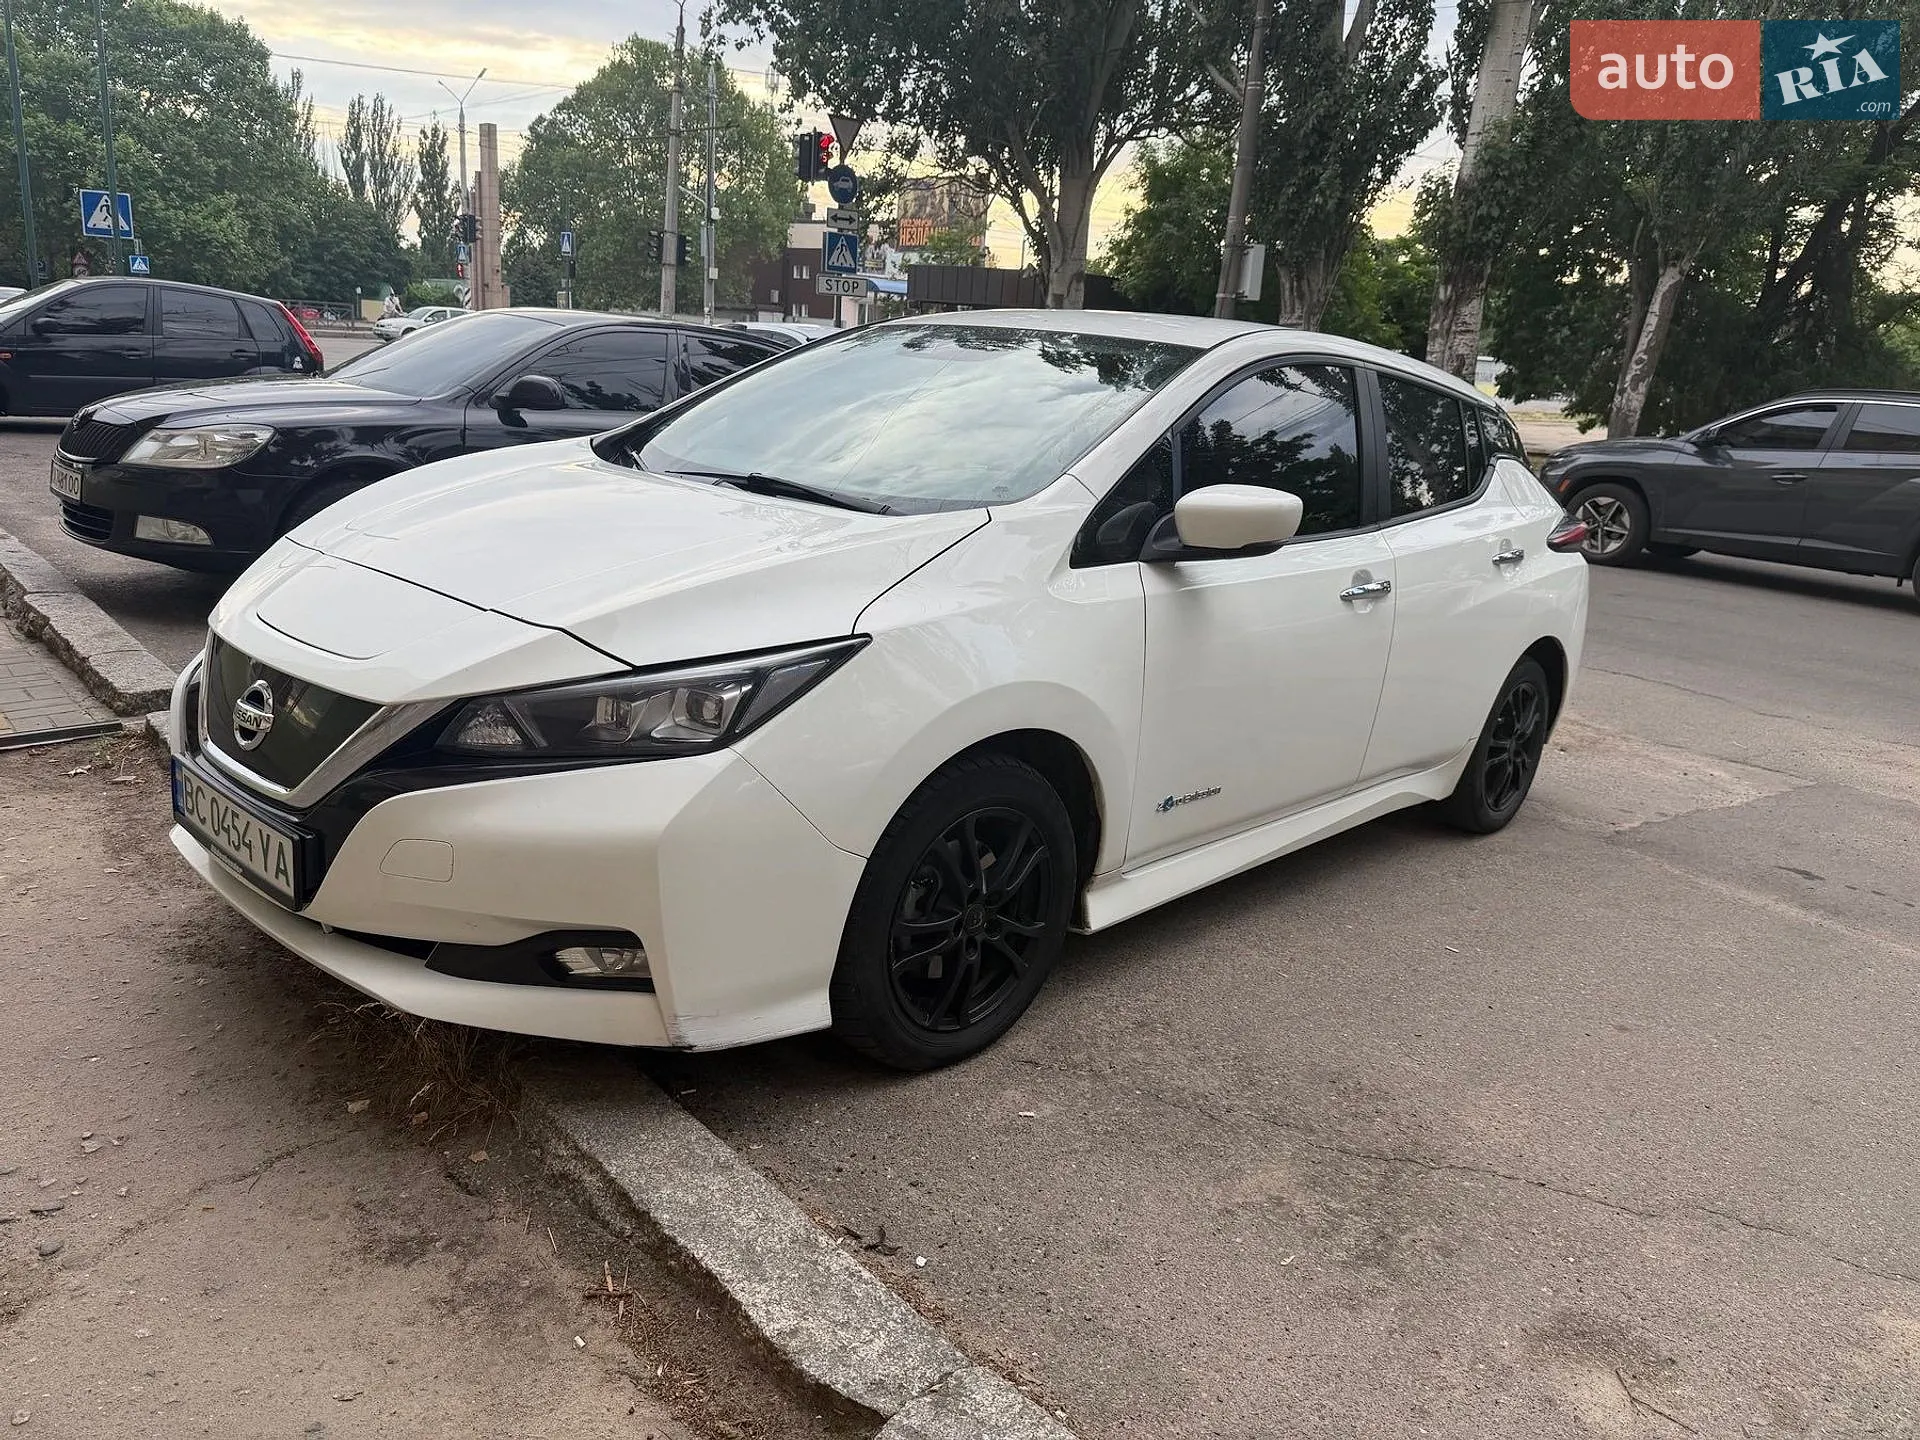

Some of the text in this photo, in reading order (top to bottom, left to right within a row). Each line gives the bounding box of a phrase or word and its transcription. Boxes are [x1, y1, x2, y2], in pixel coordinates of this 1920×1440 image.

[825, 278, 860, 294] STOP
[183, 773, 207, 826] BC
[210, 796, 253, 862] 0454
